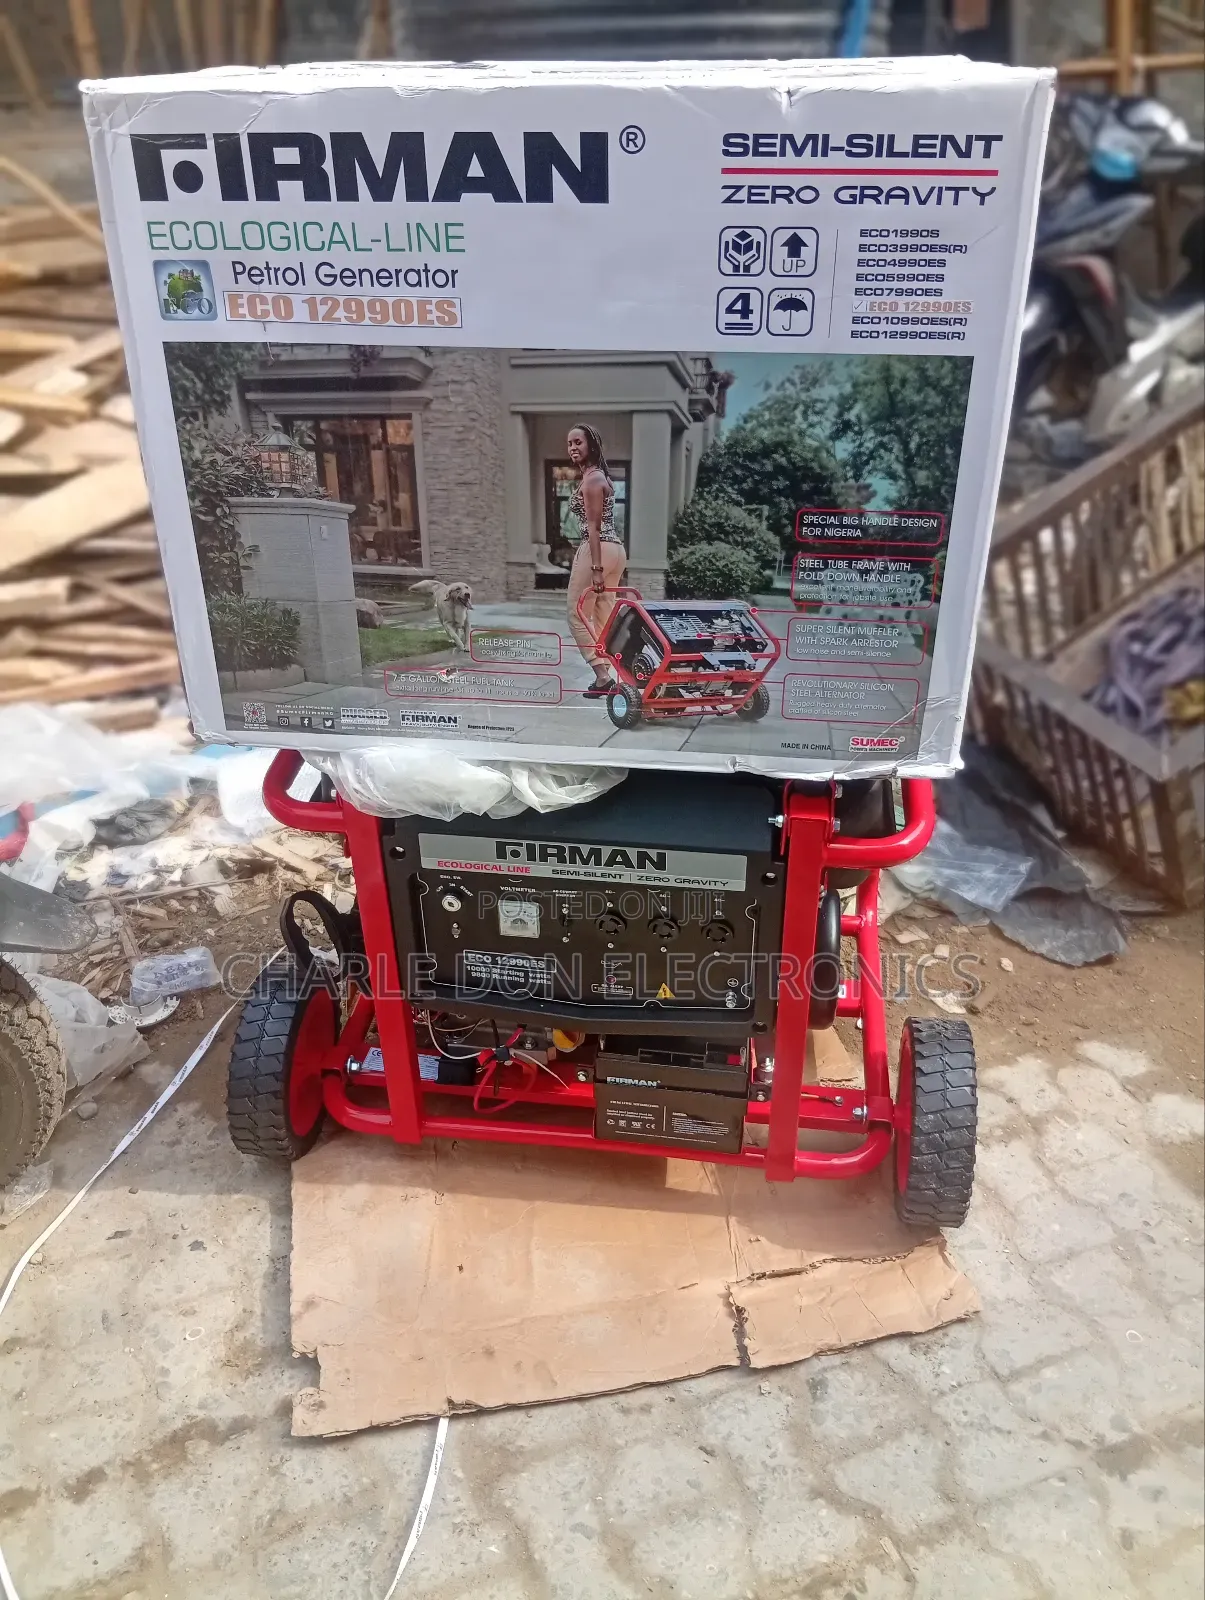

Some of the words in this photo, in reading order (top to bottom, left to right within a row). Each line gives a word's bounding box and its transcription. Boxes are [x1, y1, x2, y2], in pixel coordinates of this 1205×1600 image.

[721, 132, 1003, 159] SEMI-SILENT
[130, 131, 609, 204] FIRMAN
[720, 185, 820, 205] ZERO
[833, 185, 997, 206] GRAVITY
[147, 221, 466, 253] ECOLOGICAL-LINE
[859, 229, 940, 238] ECO1990S
[857, 243, 968, 254] ECO3990ES(R)
[782, 258, 807, 273] UP
[856, 258, 947, 268] ECO4990ES
[232, 261, 305, 287] Petrol
[315, 262, 460, 289] Generator
[855, 273, 945, 283] ECO5990ES
[854, 287, 943, 297] ECO7990ES
[227, 294, 294, 320] ECO
[307, 297, 458, 326] 12990ES
[724, 292, 753, 320] 4
[868, 301, 899, 313] ECO
[903, 301, 972, 313] 12990ES
[850, 330, 966, 341] ECO12990ES(R)
[803, 515, 840, 525] SPECIAL
[843, 516, 859, 525] BIG
[861, 517, 899, 527] HANDLE
[901, 518, 938, 528] DESIGN
[802, 527, 822, 536] FOR
[824, 528, 862, 537] NIGERIA
[799, 559, 825, 569] STEEL
[828, 560, 849, 569] TUBE
[852, 561, 885, 570] FRAME
[887, 562, 911, 571] WITH
[799, 571, 824, 580] FOLD
[827, 573, 860, 582] DOWN
[862, 574, 901, 583] HANDLE
[795, 624, 823, 633] SUPER
[826, 626, 856, 635] SILENT
[857, 627, 899, 636] MUFFLER
[478, 638, 514, 647] RELEASE
[516, 640, 532, 648] PIN
[795, 636, 818, 645] WITH
[820, 637, 848, 646] SPARK
[851, 639, 899, 648] ARRESTOR
[847, 649, 892, 658] semi-silence
[408, 674, 443, 684] GALLO
[471, 676, 490, 685] FUEL
[492, 678, 515, 687] TANK
[791, 680, 858, 690] REVOLUTIONARY
[860, 682, 895, 691] SILICON
[814, 690, 866, 700] ALTERNATOR
[401, 714, 459, 724] FIRMAN
[781, 742, 801, 750] MADE
[810, 743, 832, 751] CHINA
[850, 737, 899, 747] SUMEC
[495, 840, 667, 871] FIRMAN
[437, 860, 504, 874] ECOLOGICAL
[507, 865, 531, 875] LINE
[551, 868, 624, 881] SEMI-SILENT
[636, 875, 672, 885] ZERO
[674, 877, 729, 888] GRAVITY
[500, 885, 536, 893] VOLTMETER
[467, 953, 492, 963] ECO
[495, 956, 546, 968] 12990ES
[466, 965, 491, 973] 10000
[491, 968, 525, 978] Starting
[471, 971, 491, 979] 9800
[491, 974, 525, 983] Running
[606, 1076, 658, 1087] FIRMAN
